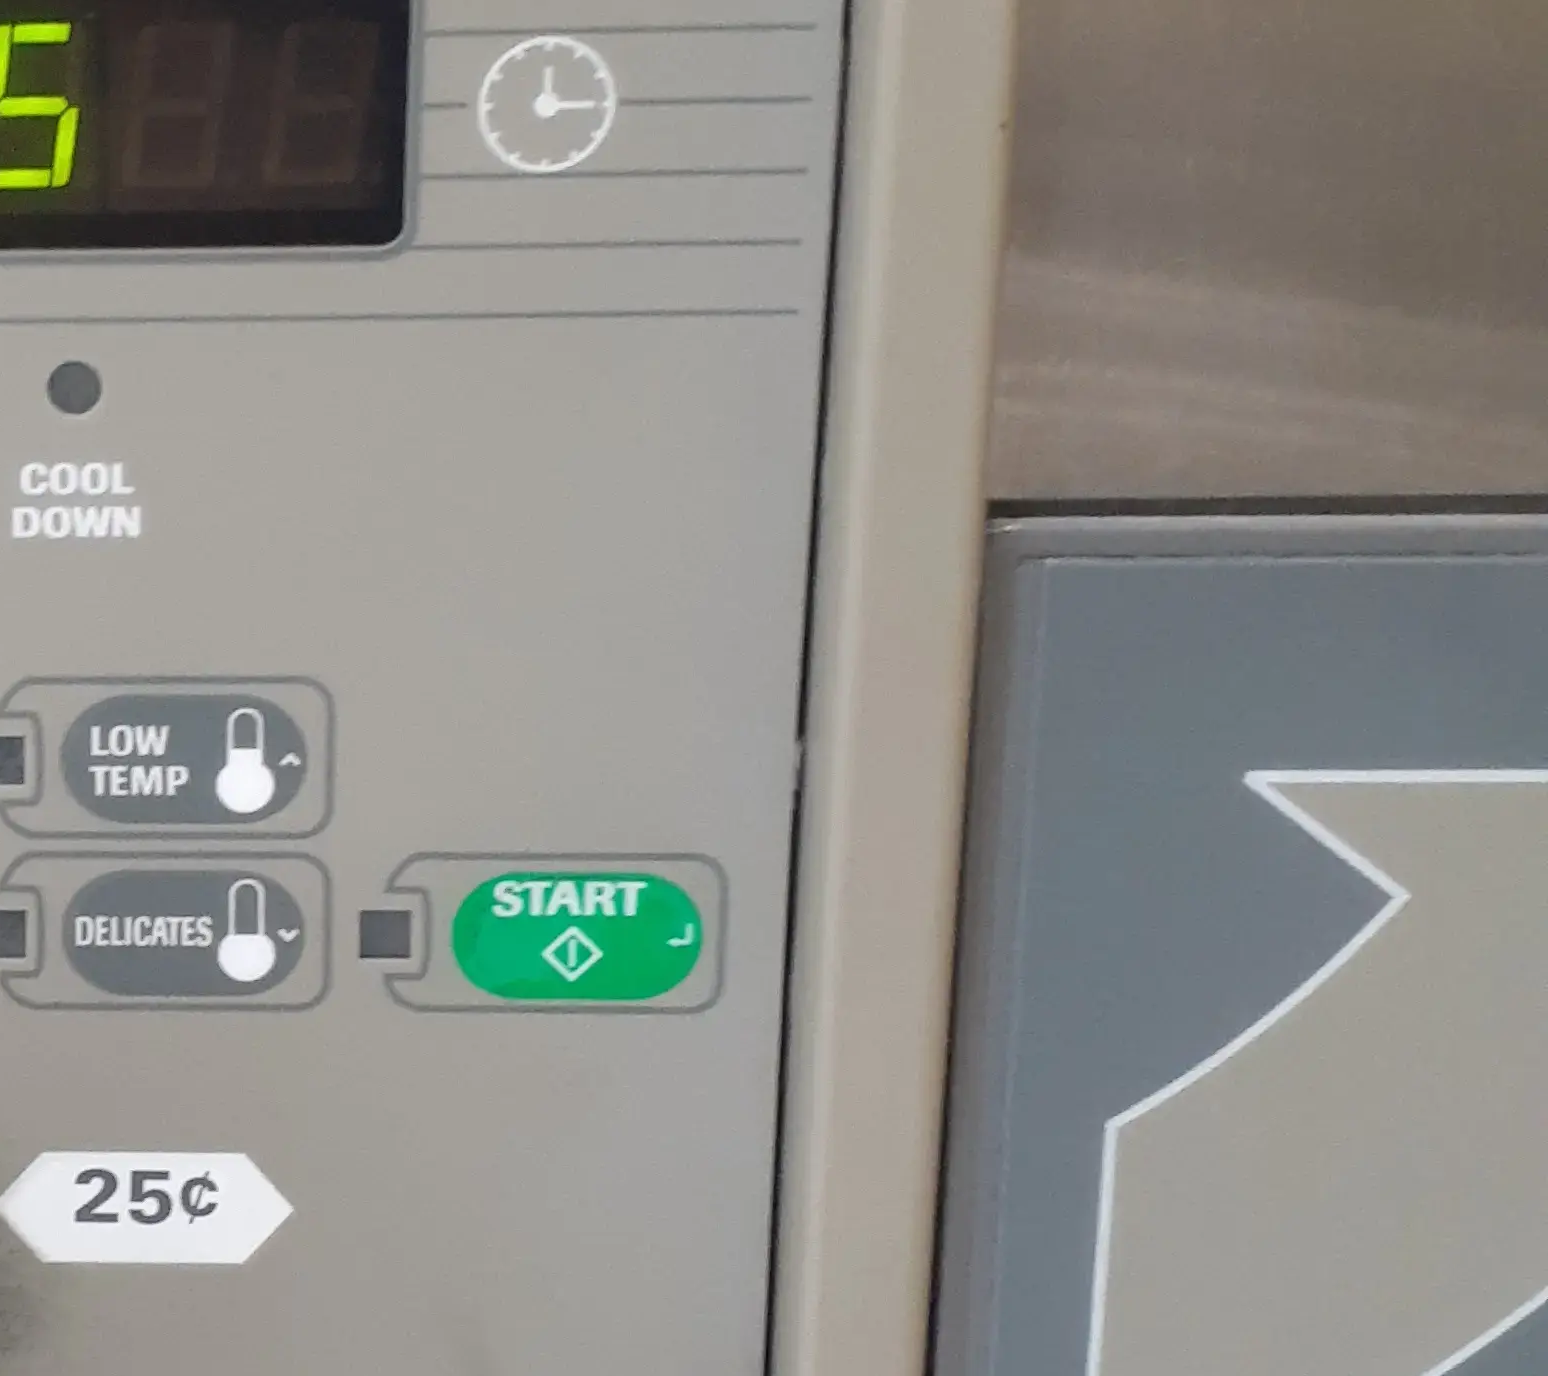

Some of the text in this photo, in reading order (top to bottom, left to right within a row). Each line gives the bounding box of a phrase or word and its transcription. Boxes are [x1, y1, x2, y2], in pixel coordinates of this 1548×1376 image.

[19, 462, 135, 496] COOL
[11, 506, 142, 539] DOWN
[89, 724, 171, 757] LOW
[88, 765, 191, 797] TEMP
[491, 880, 648, 917] START
[74, 915, 215, 948] DELICATES
[73, 1169, 221, 1226] 25¢
